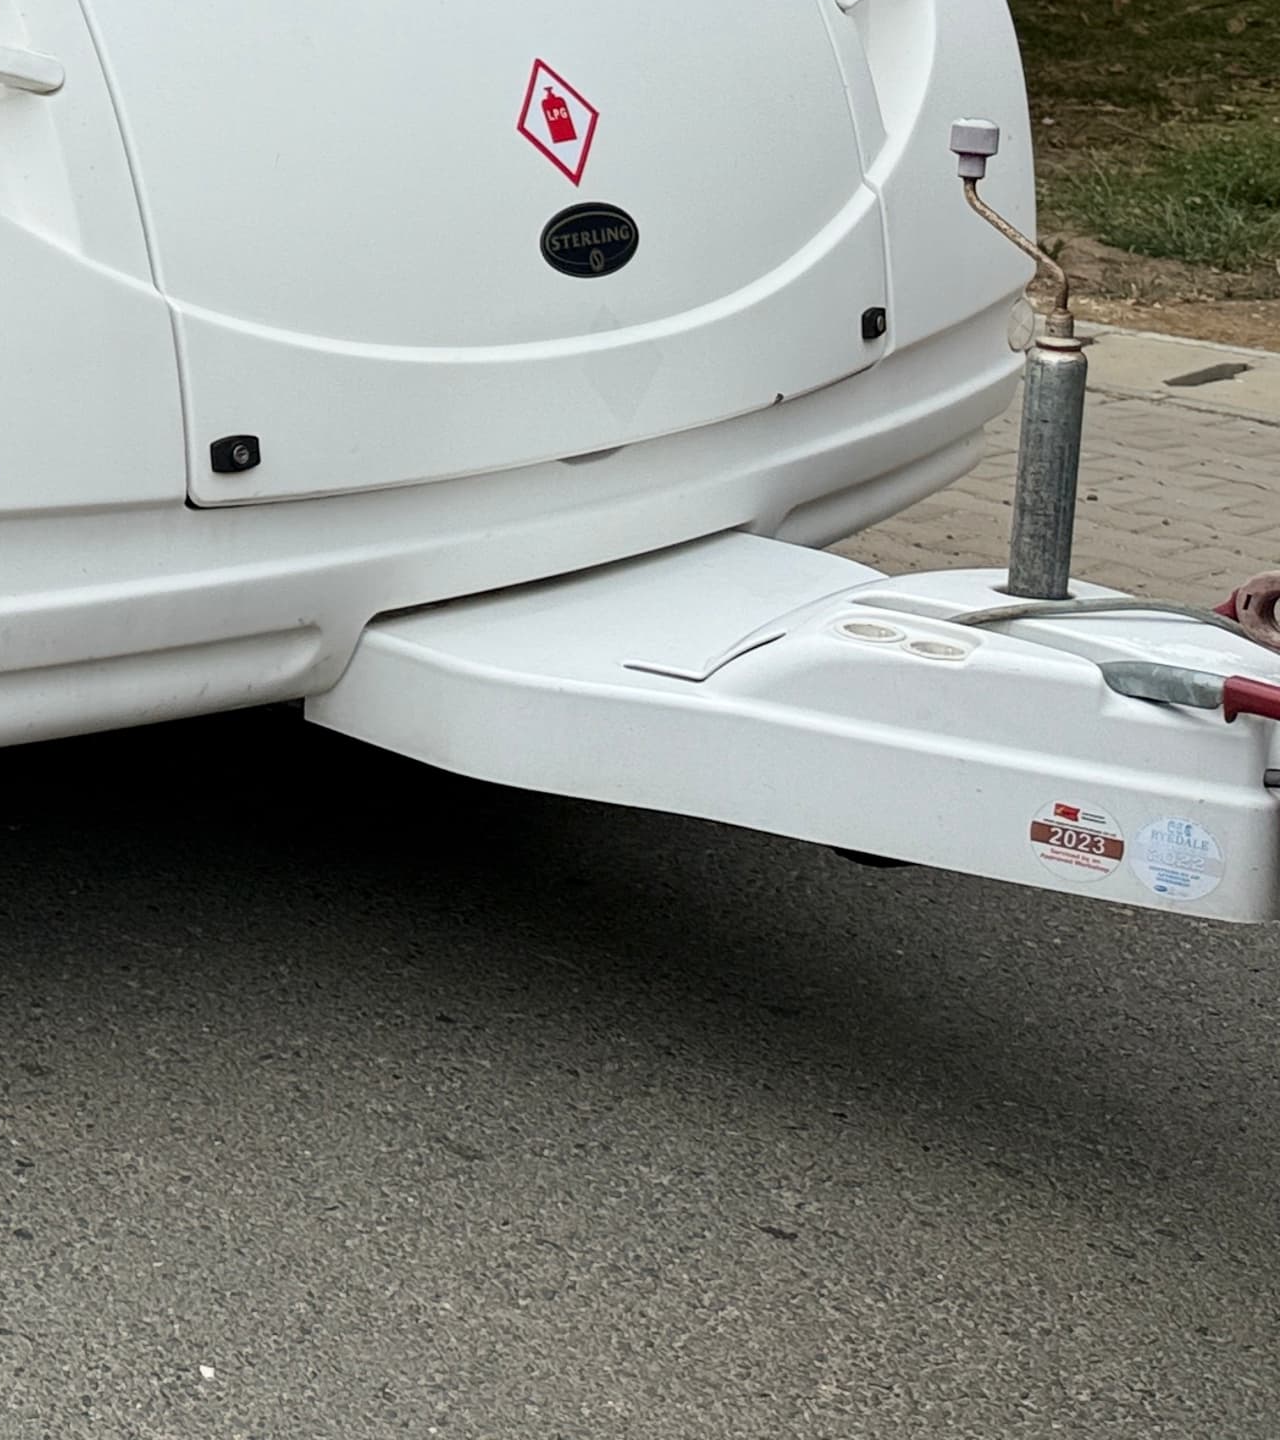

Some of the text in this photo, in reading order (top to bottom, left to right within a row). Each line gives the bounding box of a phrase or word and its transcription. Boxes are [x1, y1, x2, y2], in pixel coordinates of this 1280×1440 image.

[546, 107, 568, 122] LPG
[550, 225, 630, 252] STERLING
[1049, 827, 1105, 854] 2023
